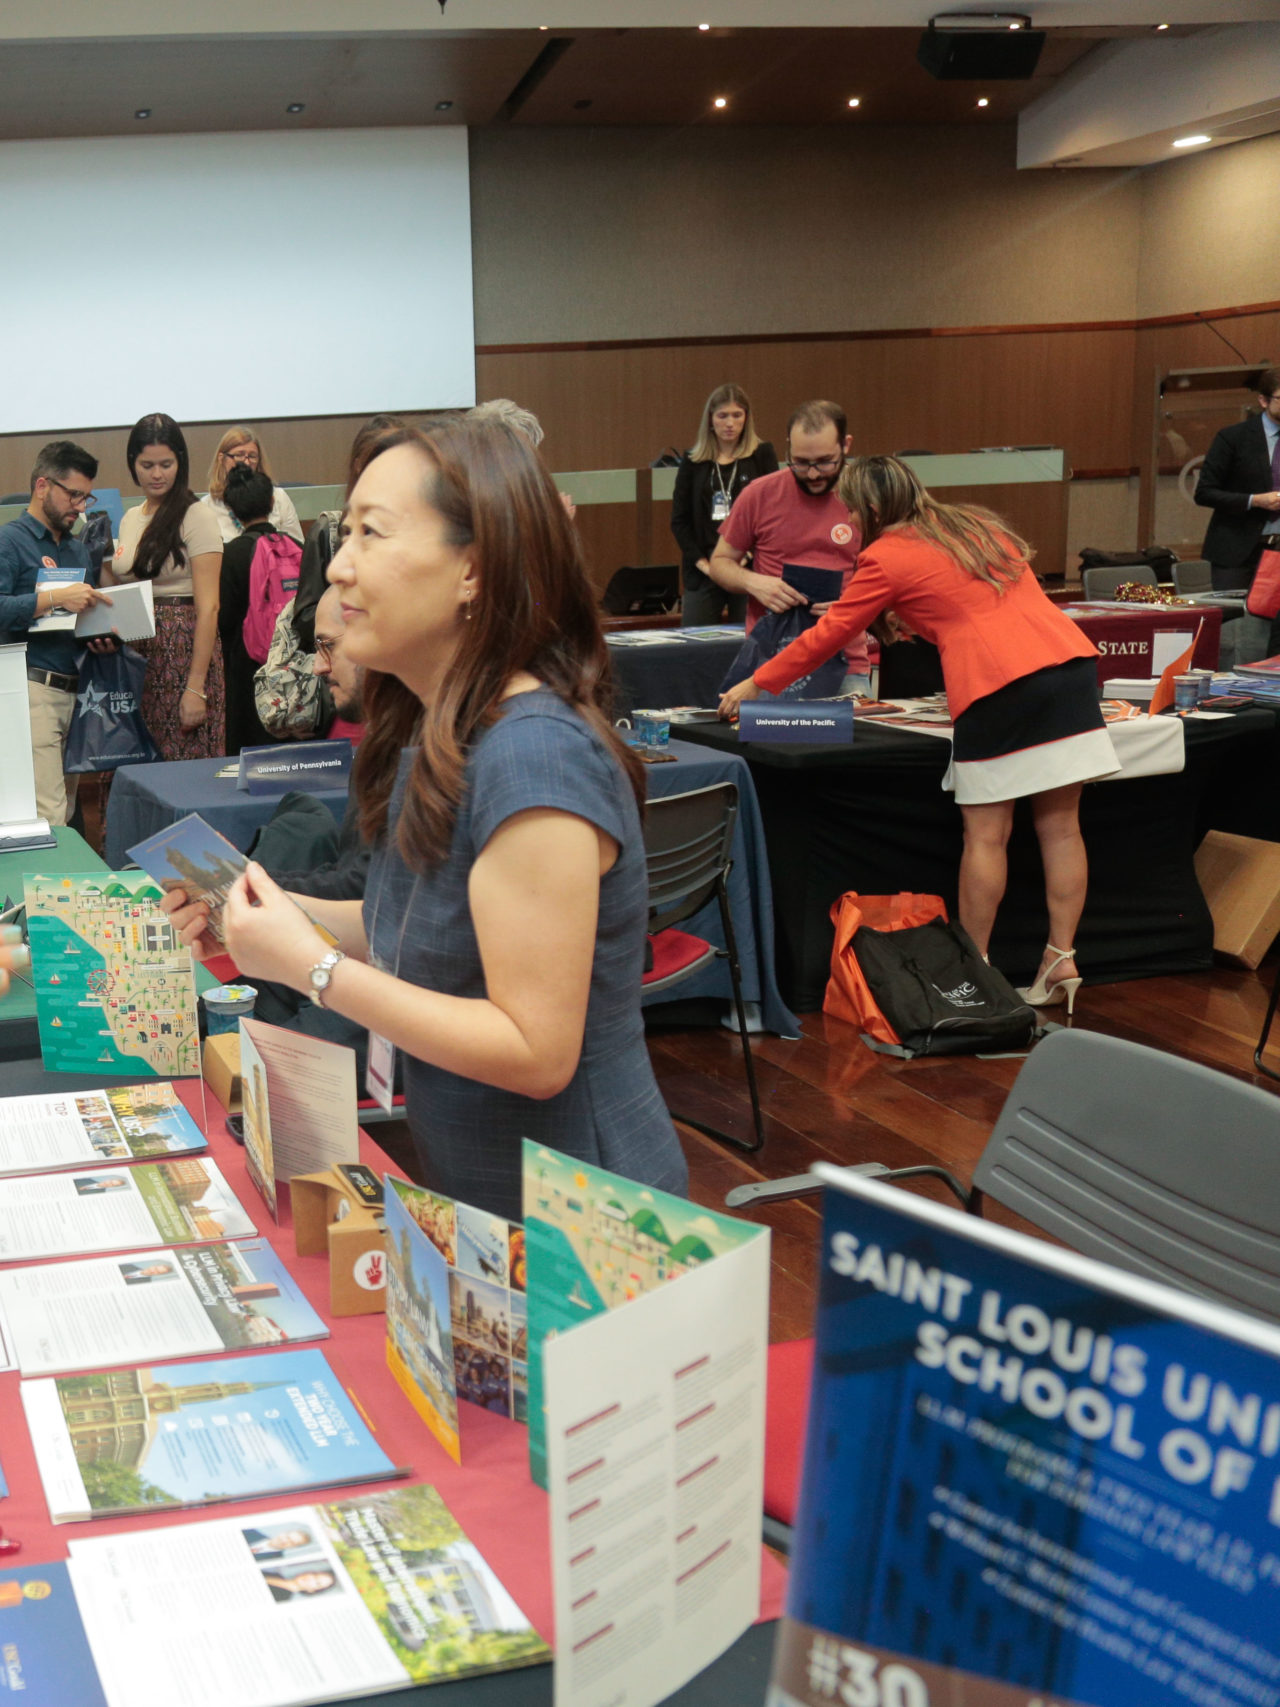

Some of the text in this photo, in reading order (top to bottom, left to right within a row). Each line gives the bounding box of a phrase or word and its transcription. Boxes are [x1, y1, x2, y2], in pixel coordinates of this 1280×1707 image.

[1098, 640, 1149, 656] STATE
[756, 719, 790, 727] University
[257, 759, 342, 774] University of Pennsylvania
[53, 1101, 68, 1118] TOP
[111, 1093, 146, 1136] WHY USC?
[197, 1249, 216, 1268] LLM
[183, 1258, 219, 1305] Cybersecurity
[830, 1231, 1280, 1458] SAINT LOUIS UNI
[285, 1383, 330, 1449] EXTENDED LLM
[304, 1392, 338, 1437] TWO YEAR
[916, 1322, 1146, 1460] SCHOOL
[1159, 1429, 1256, 1499] OF
[807, 1636, 929, 1707] #30
